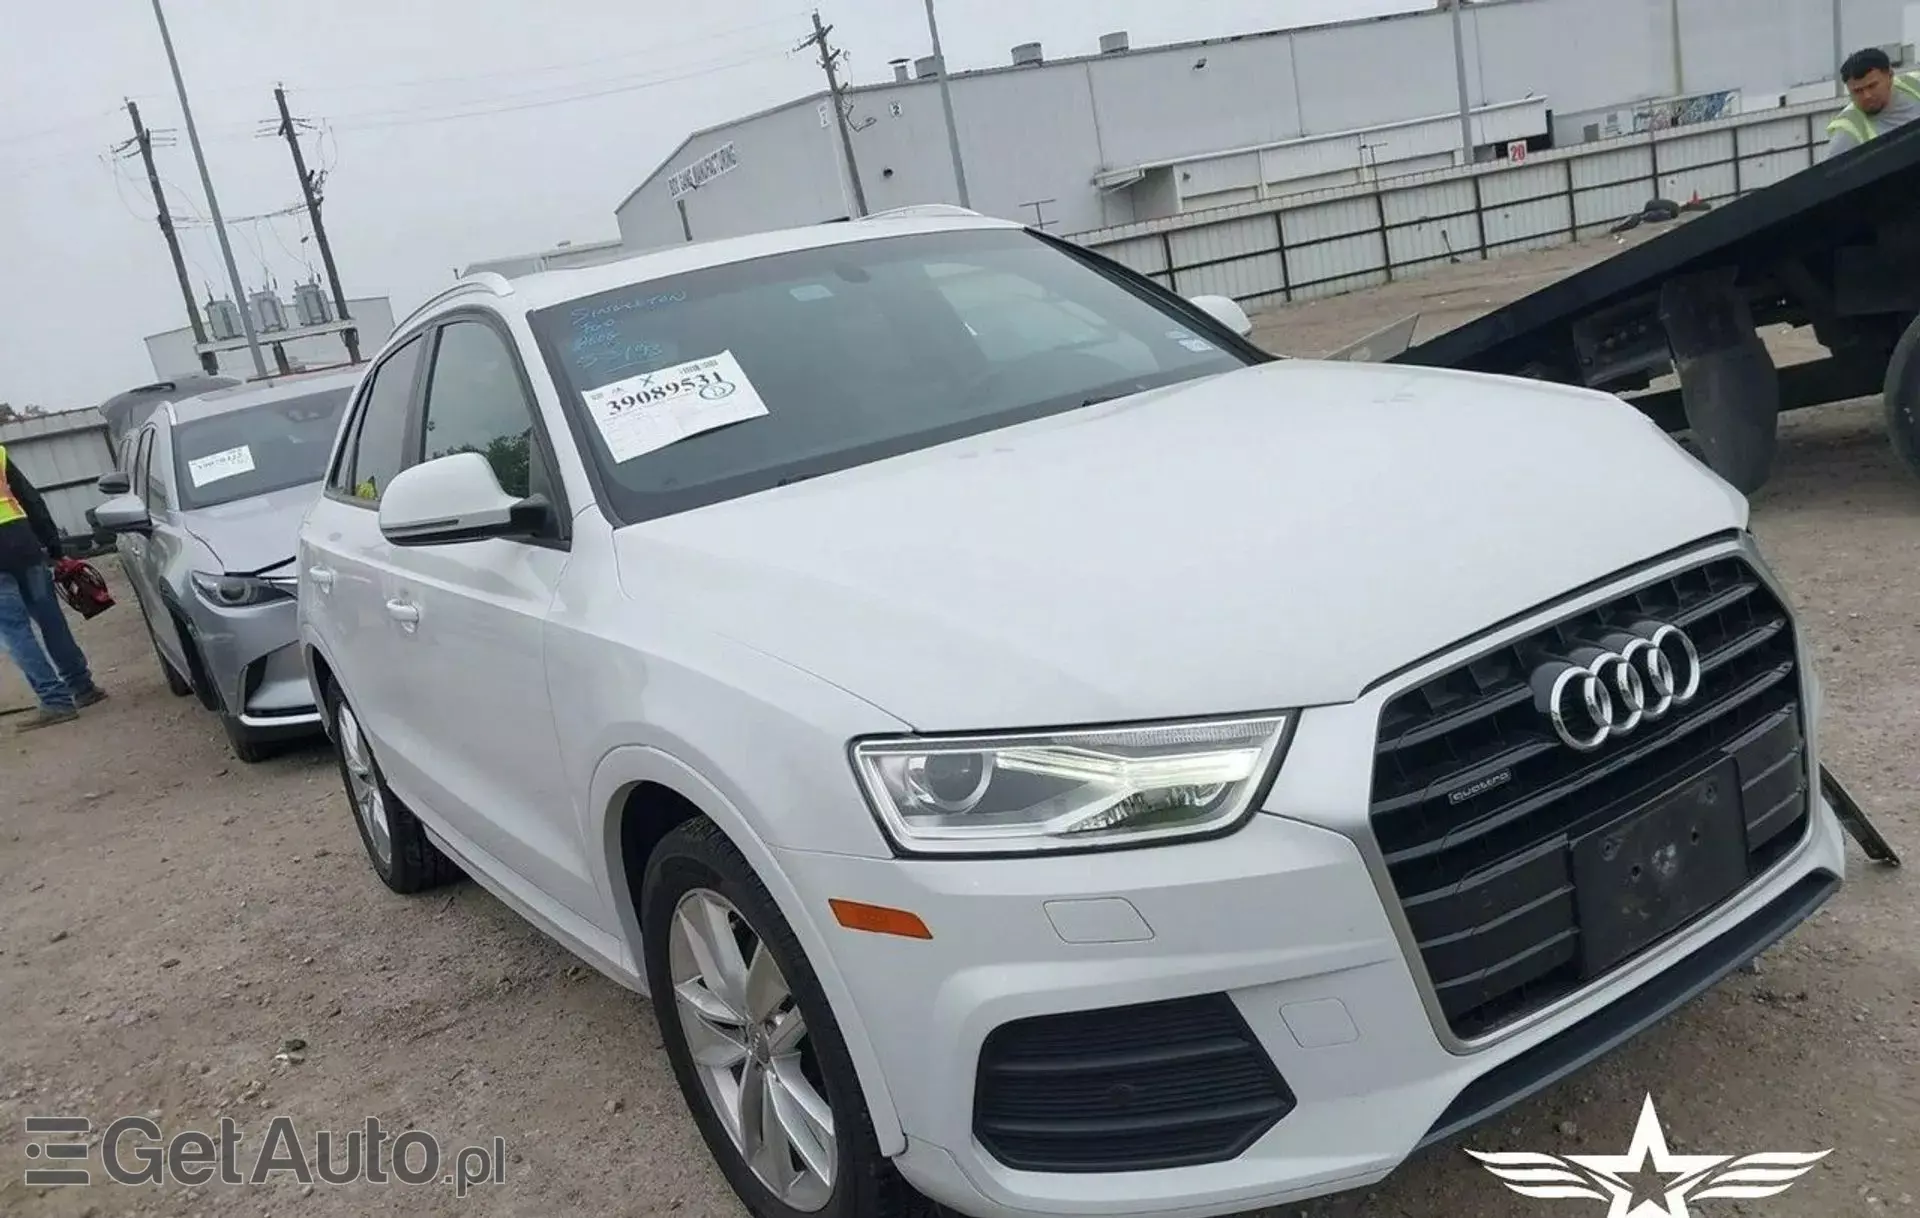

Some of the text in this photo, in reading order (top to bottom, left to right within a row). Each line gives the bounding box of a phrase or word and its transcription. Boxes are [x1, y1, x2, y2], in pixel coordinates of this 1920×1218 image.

[1510, 144, 1525, 162] 20
[606, 371, 724, 416] 39089531
[1453, 772, 1509, 800] quattro
